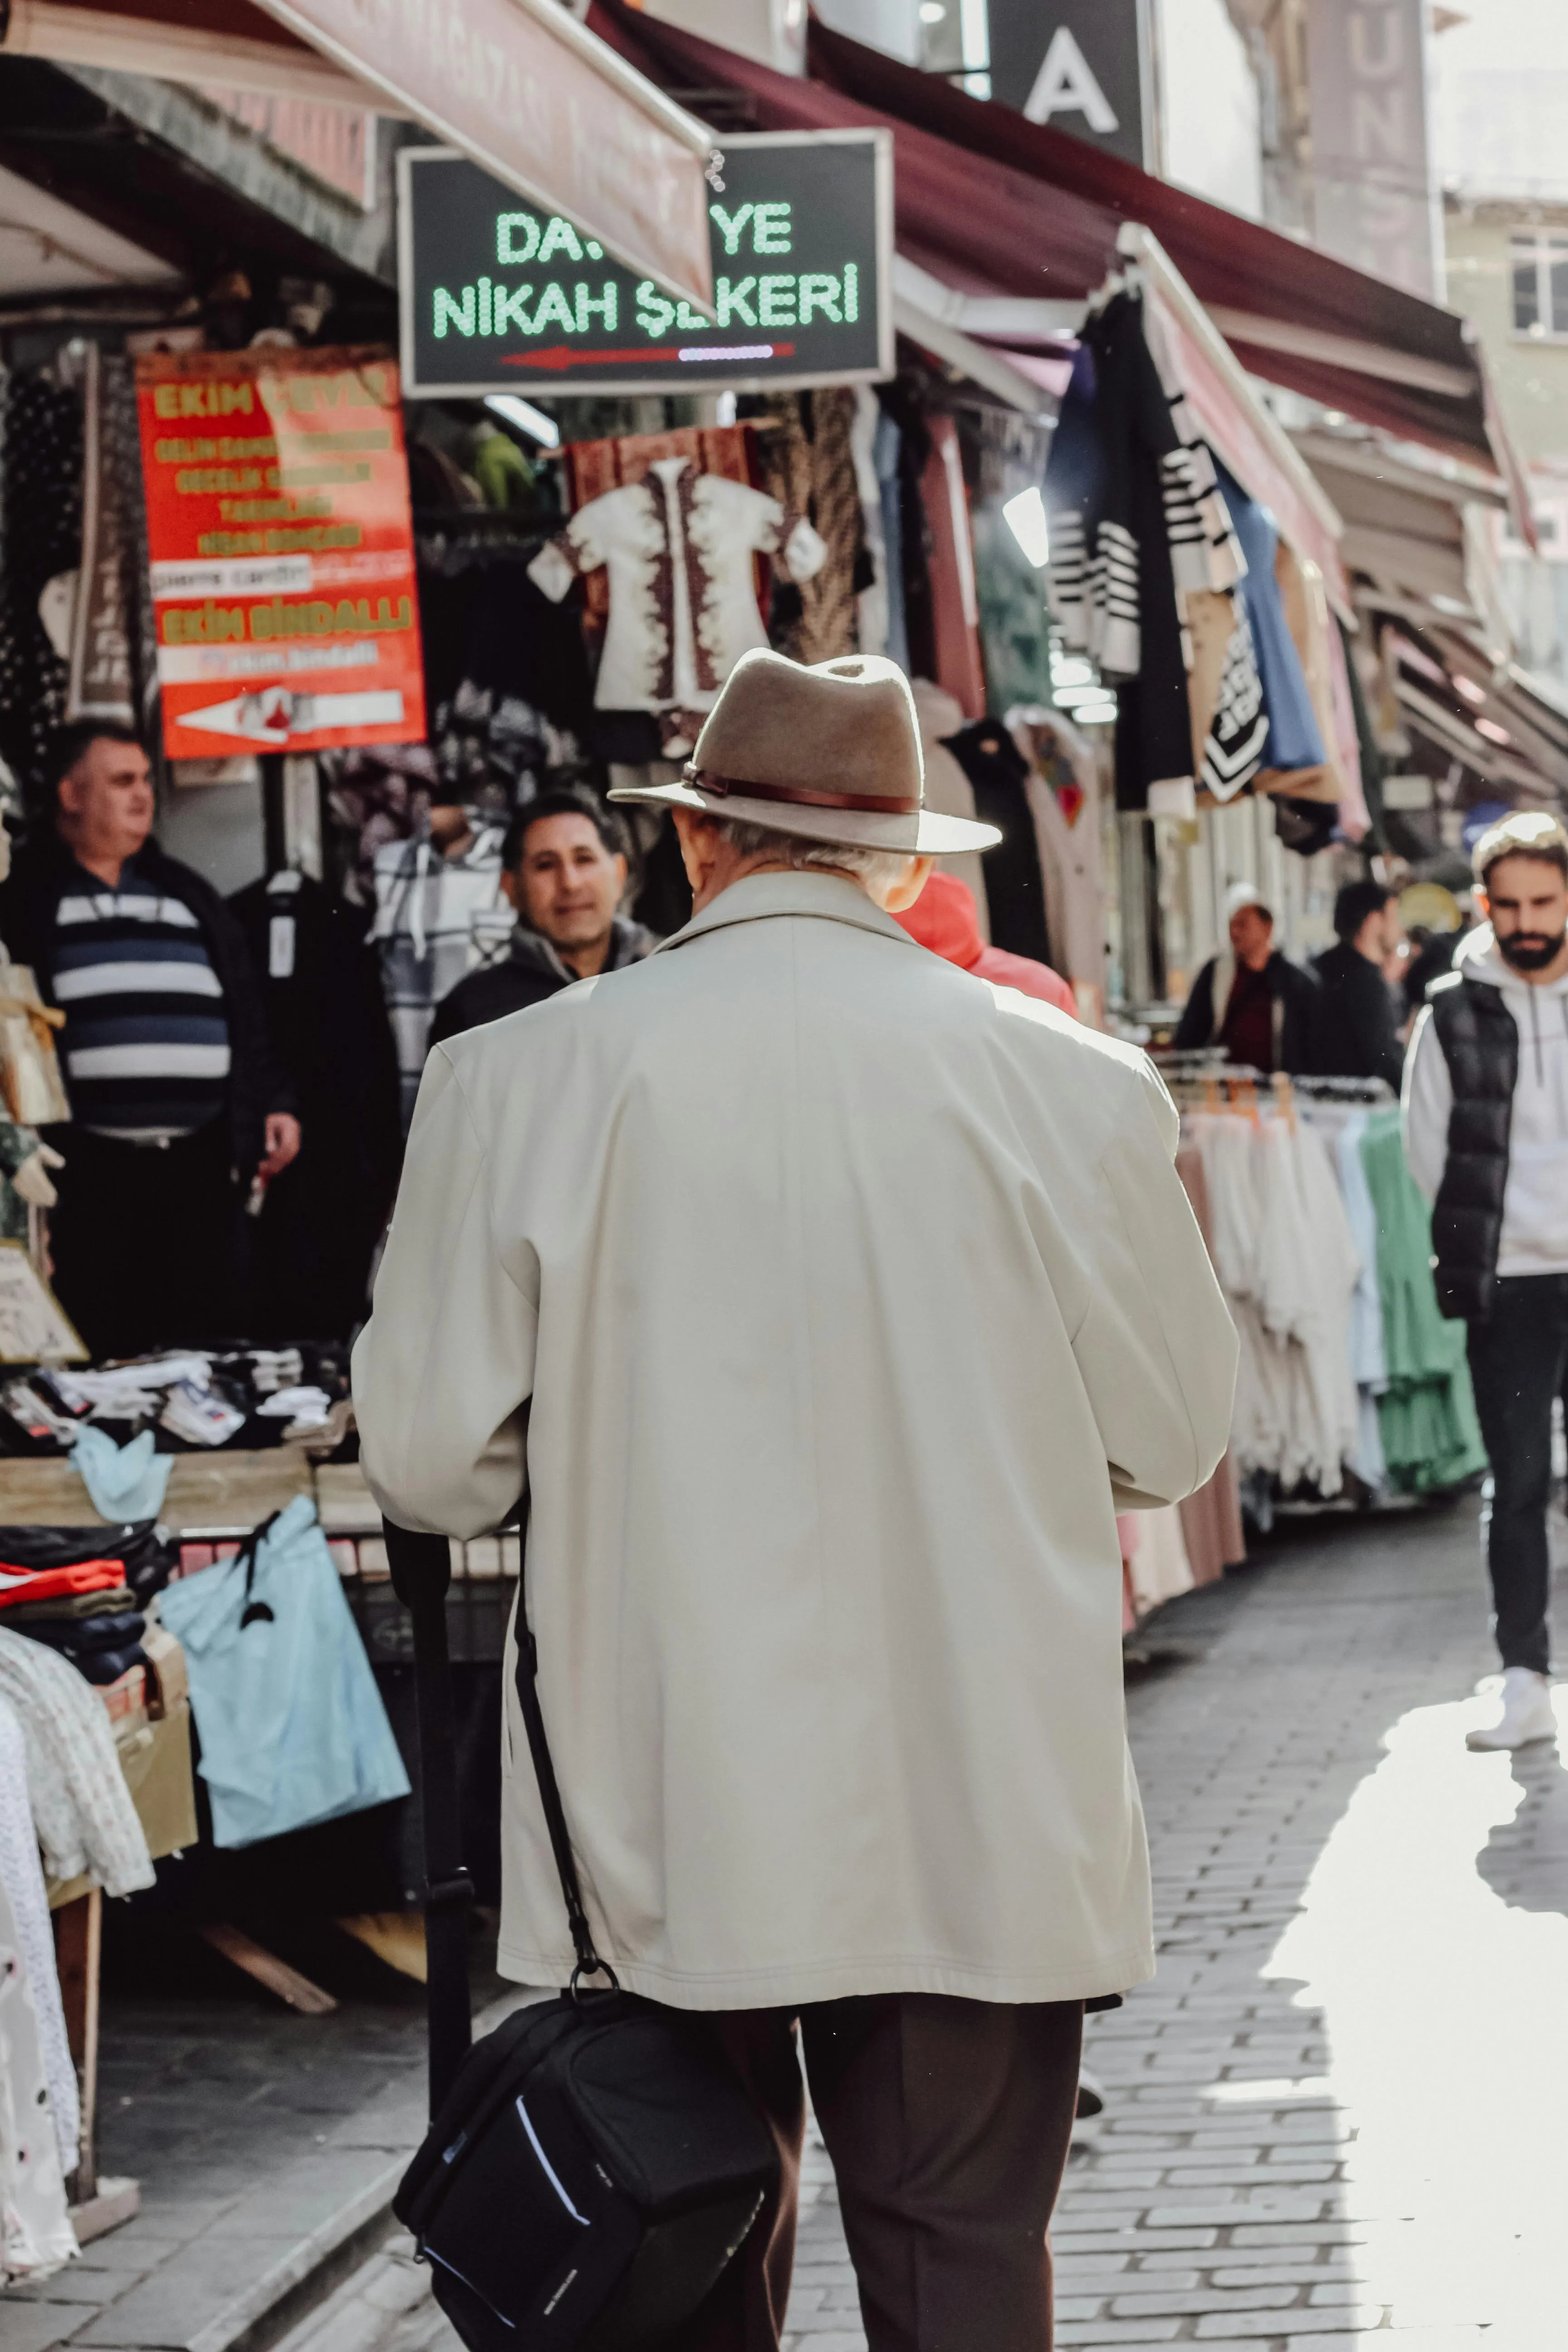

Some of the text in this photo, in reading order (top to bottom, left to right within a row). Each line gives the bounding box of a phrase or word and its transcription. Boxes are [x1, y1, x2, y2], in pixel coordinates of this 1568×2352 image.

[1024, 26, 1119, 132] A
[432, 275, 619, 339] NİKAH
[163, 595, 411, 644] EKİM BİNDALLI
